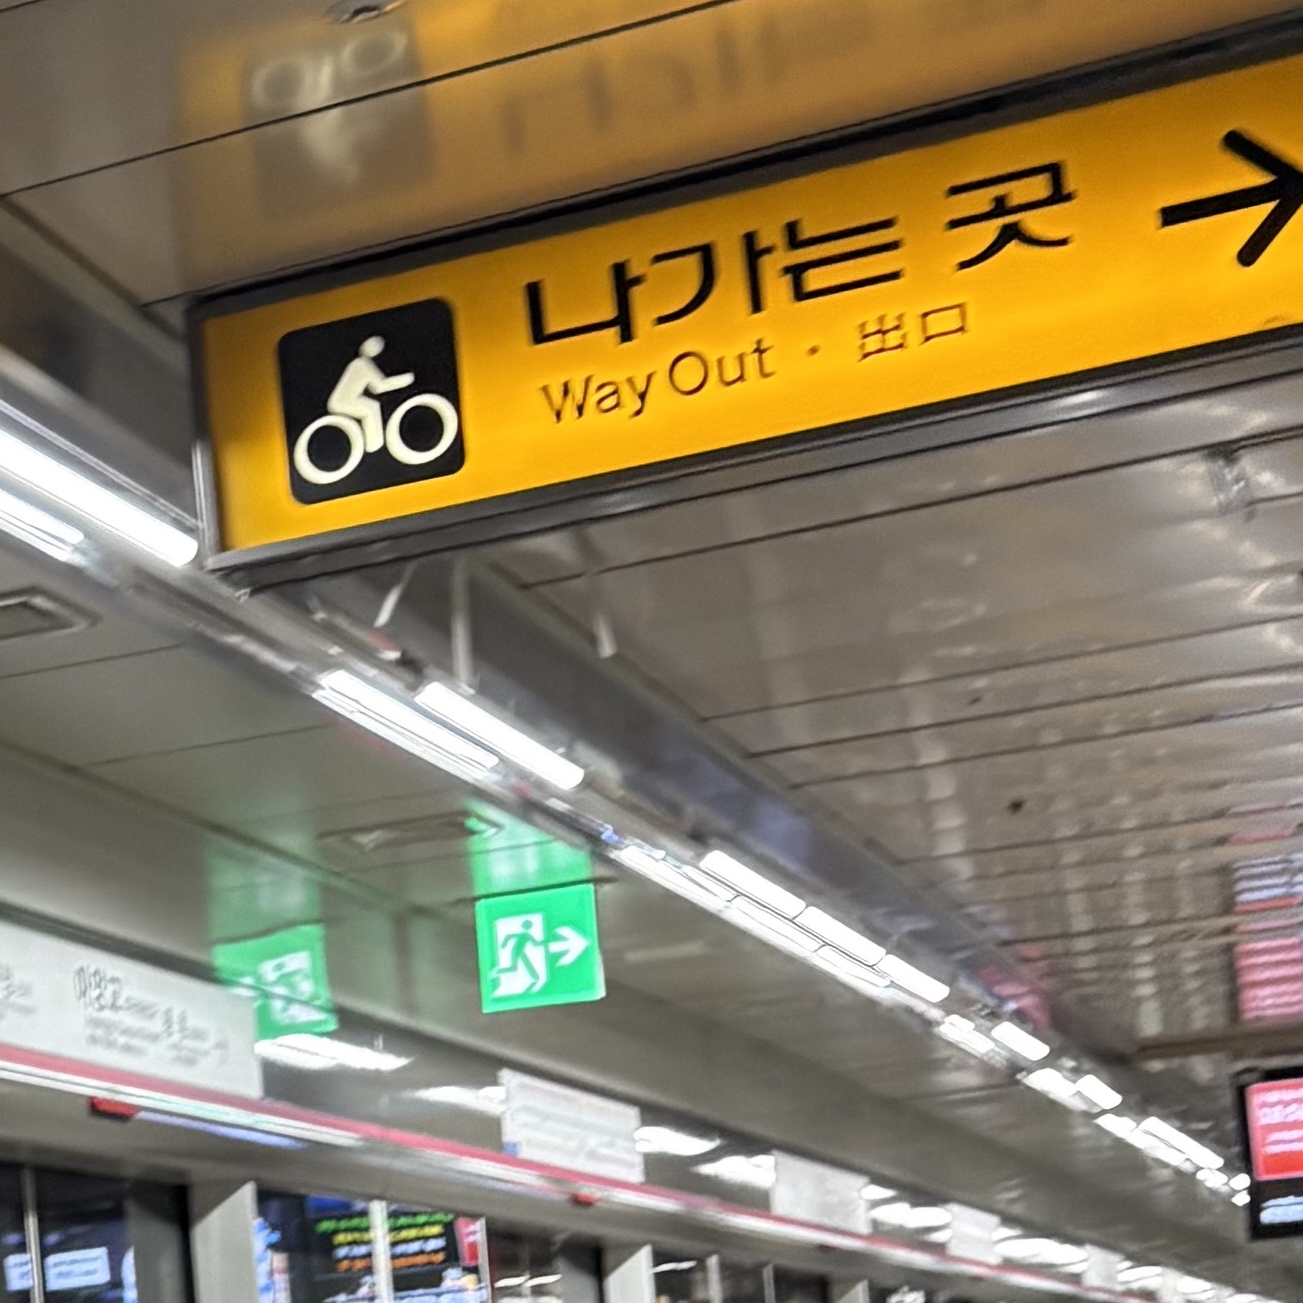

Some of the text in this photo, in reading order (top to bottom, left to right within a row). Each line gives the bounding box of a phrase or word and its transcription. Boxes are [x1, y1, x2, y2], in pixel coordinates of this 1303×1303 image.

[525, 160, 1077, 345] 나가는 곳
[857, 301, 969, 363] 出口
[540, 338, 775, 425] Way Out
